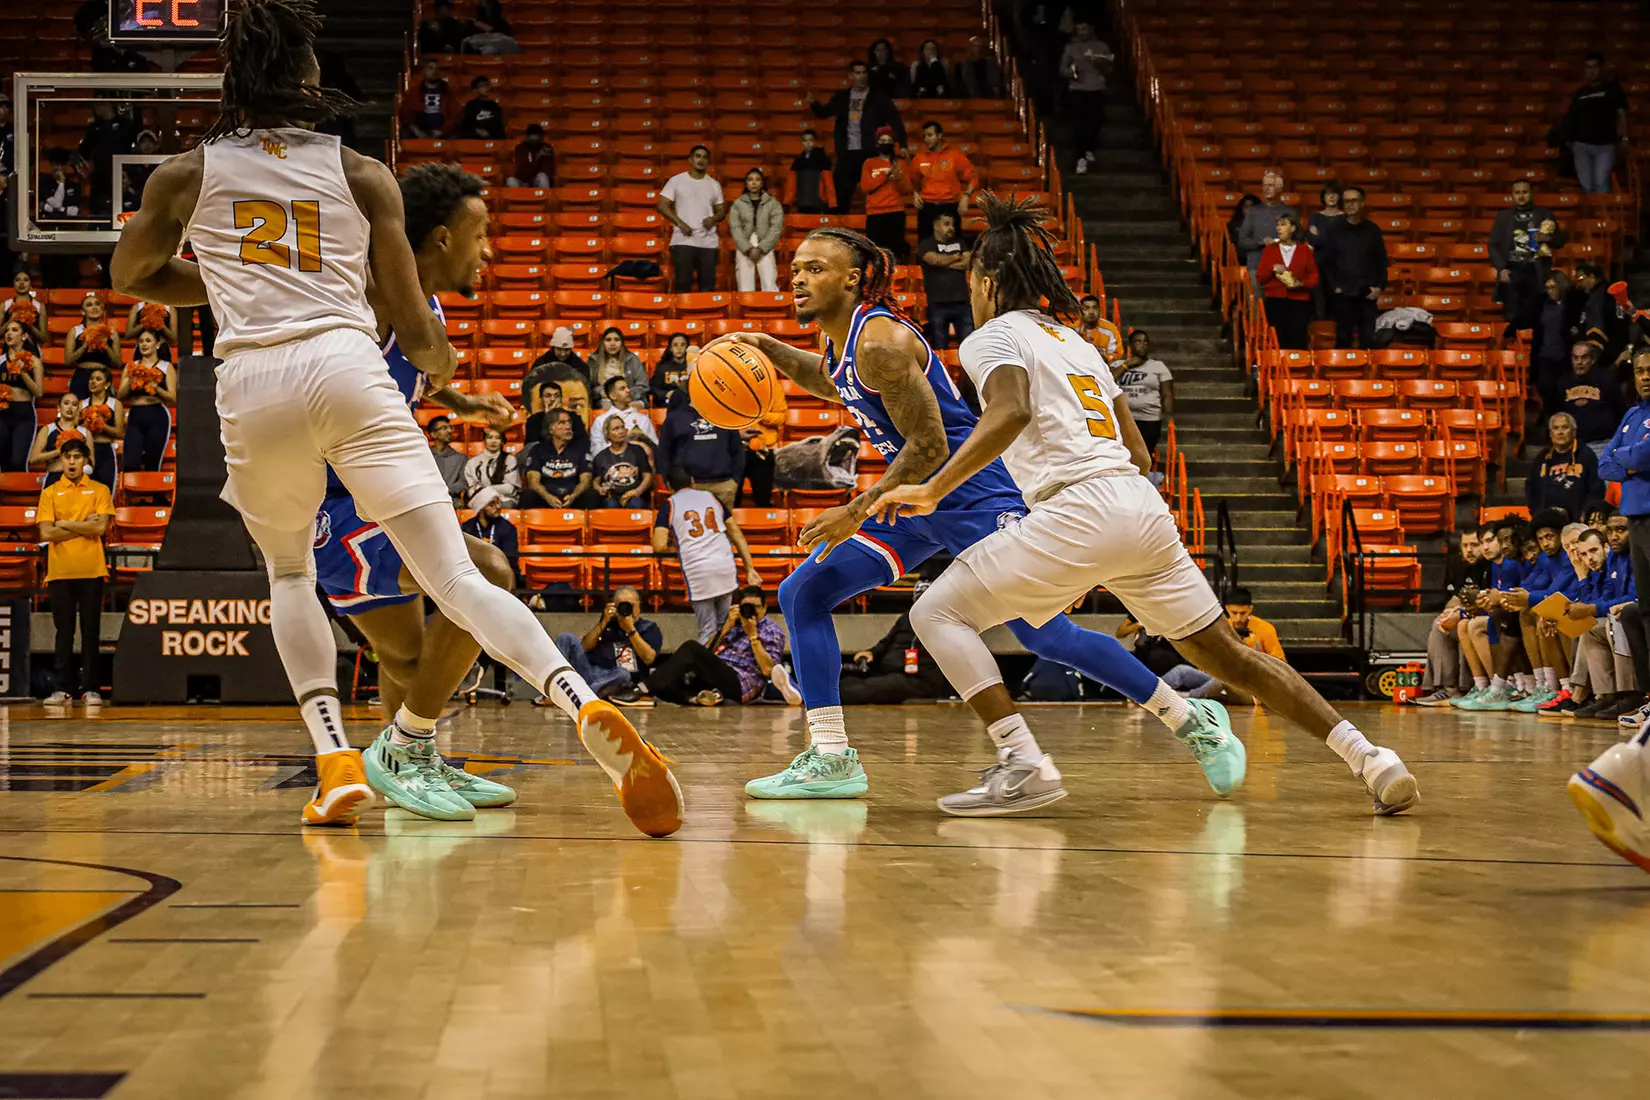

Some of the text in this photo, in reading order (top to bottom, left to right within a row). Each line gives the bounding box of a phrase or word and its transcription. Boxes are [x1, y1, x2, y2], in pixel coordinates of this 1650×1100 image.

[259, 136, 288, 160] TWC
[232, 199, 322, 273] 21
[1065, 373, 1117, 441] 5
[683, 506, 720, 538] 34
[128, 599, 273, 625] SPEAKING
[161, 630, 250, 657] ROCK
